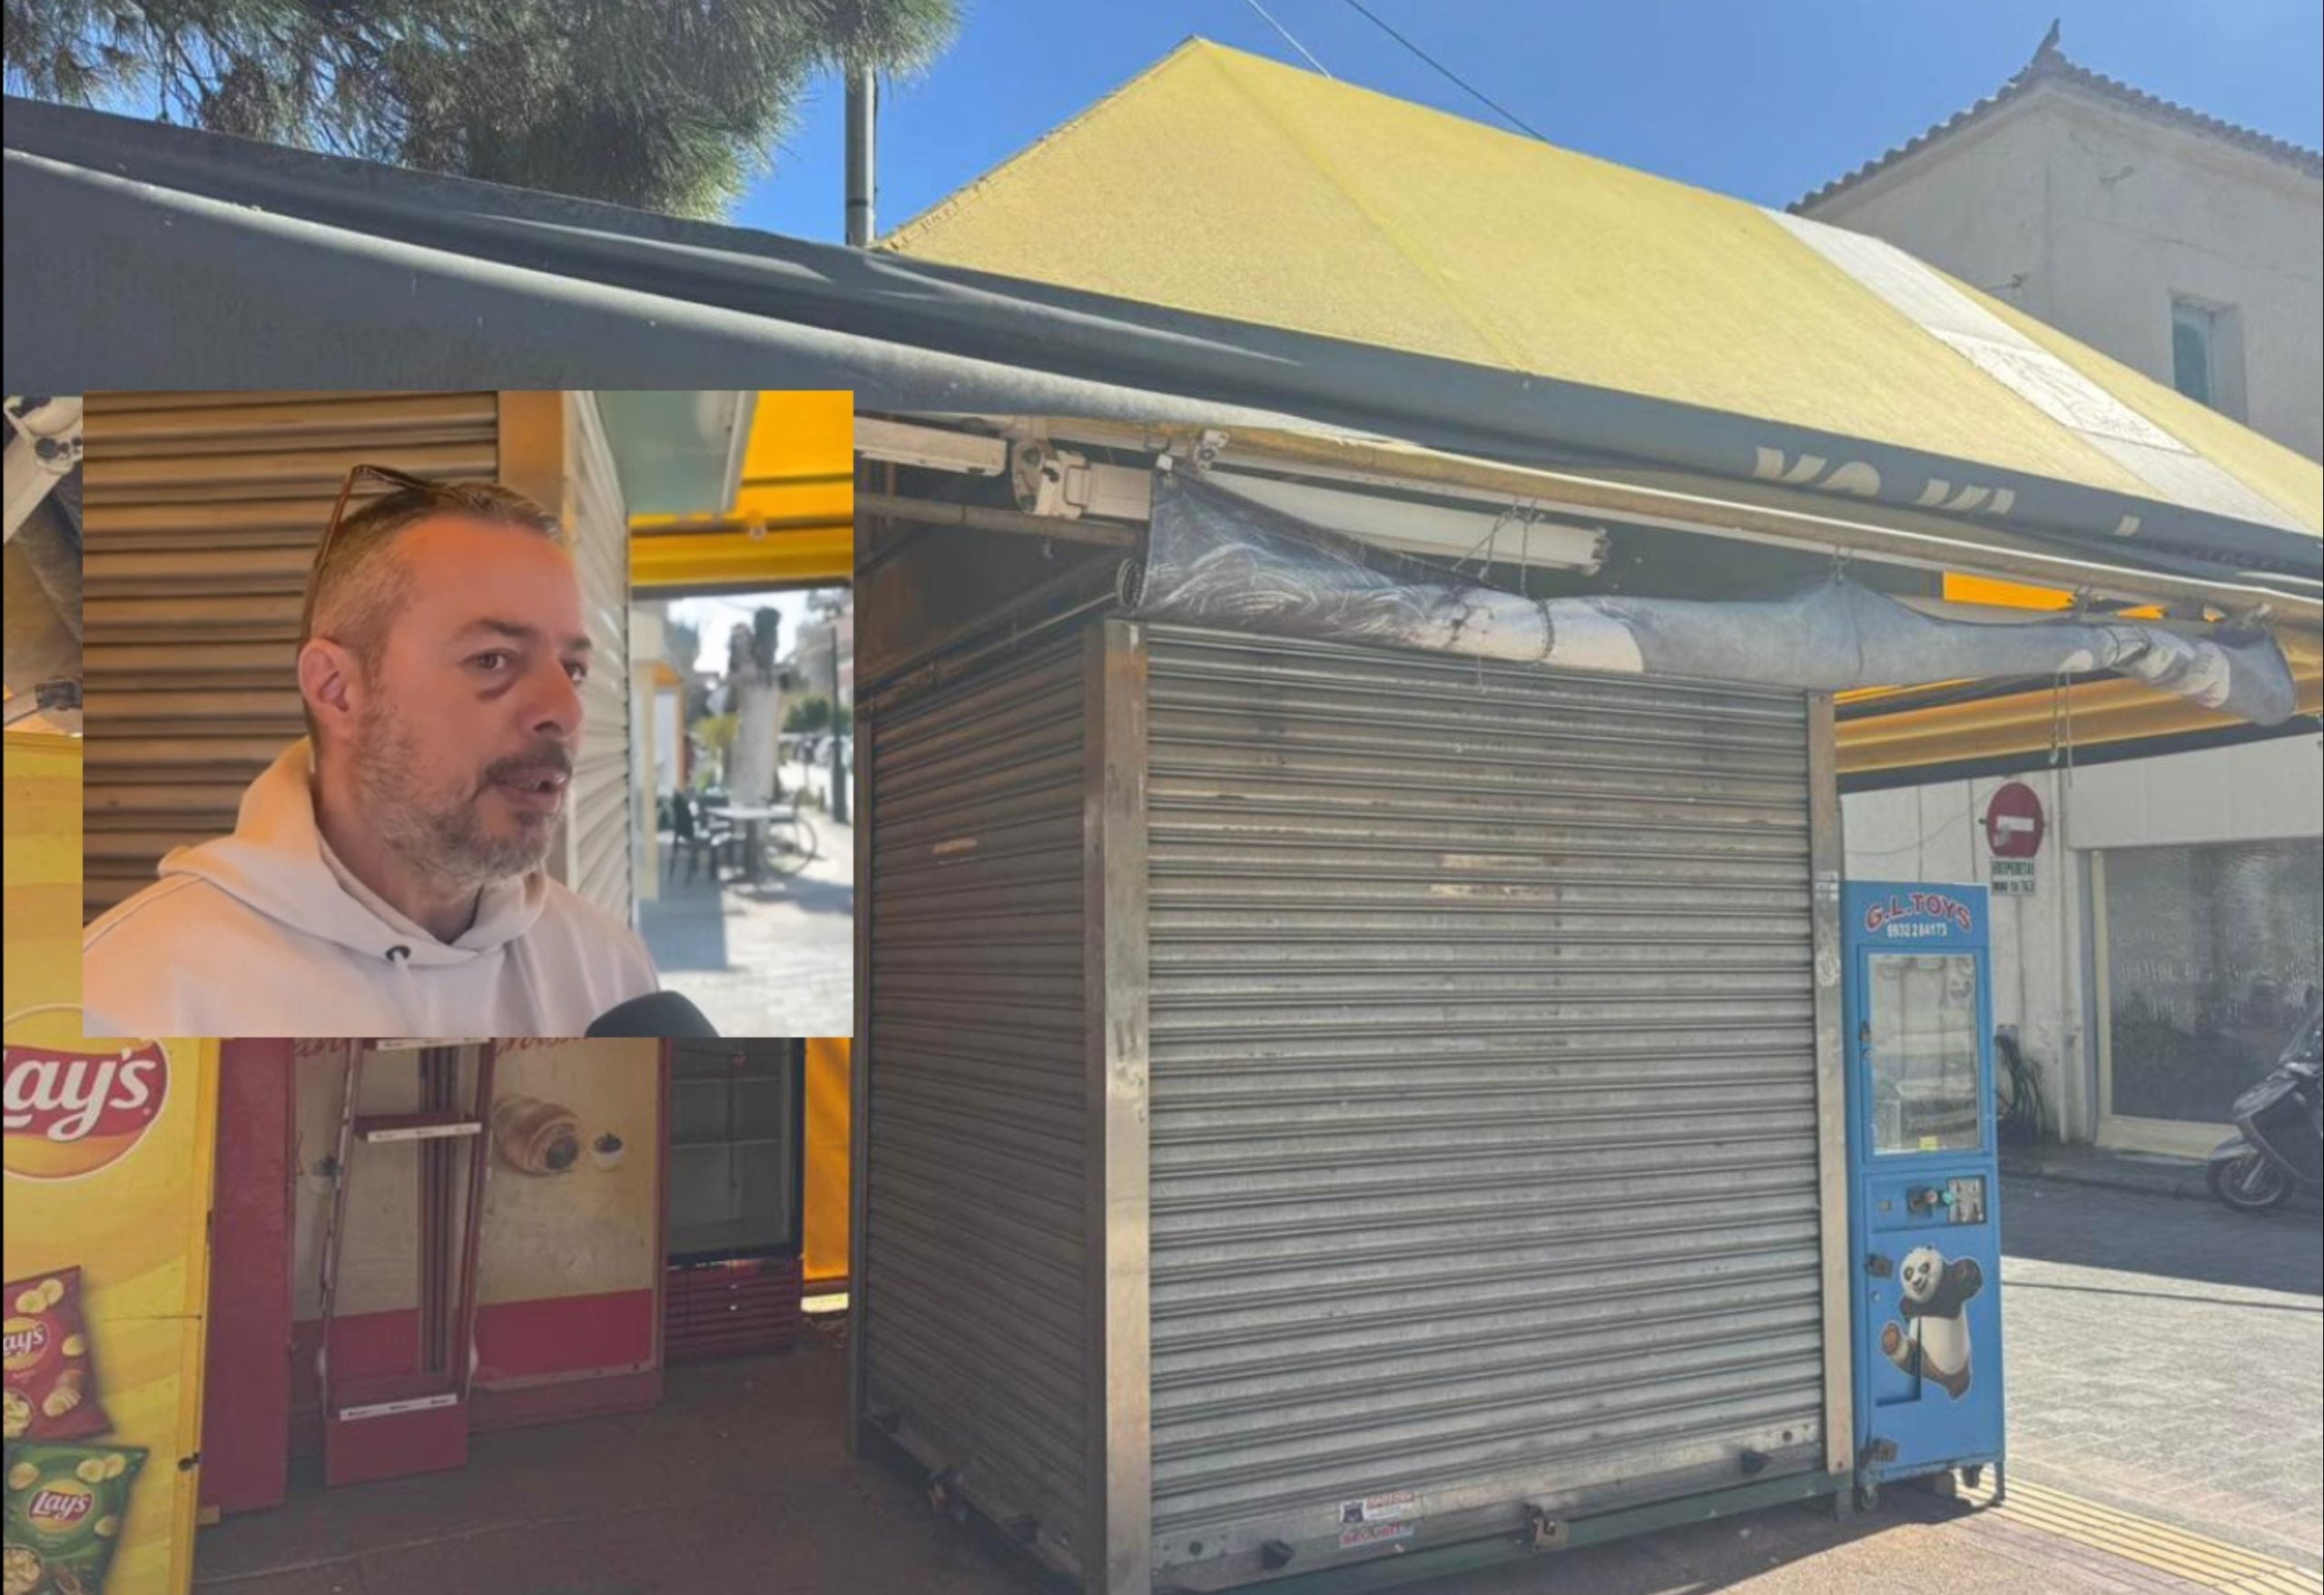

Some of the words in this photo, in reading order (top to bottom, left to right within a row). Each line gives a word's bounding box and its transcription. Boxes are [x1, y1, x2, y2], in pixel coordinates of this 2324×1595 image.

[4, 1047, 157, 1141] ay's
[4, 1323, 44, 1356] ay's
[31, 1491, 90, 1520] Lay's
